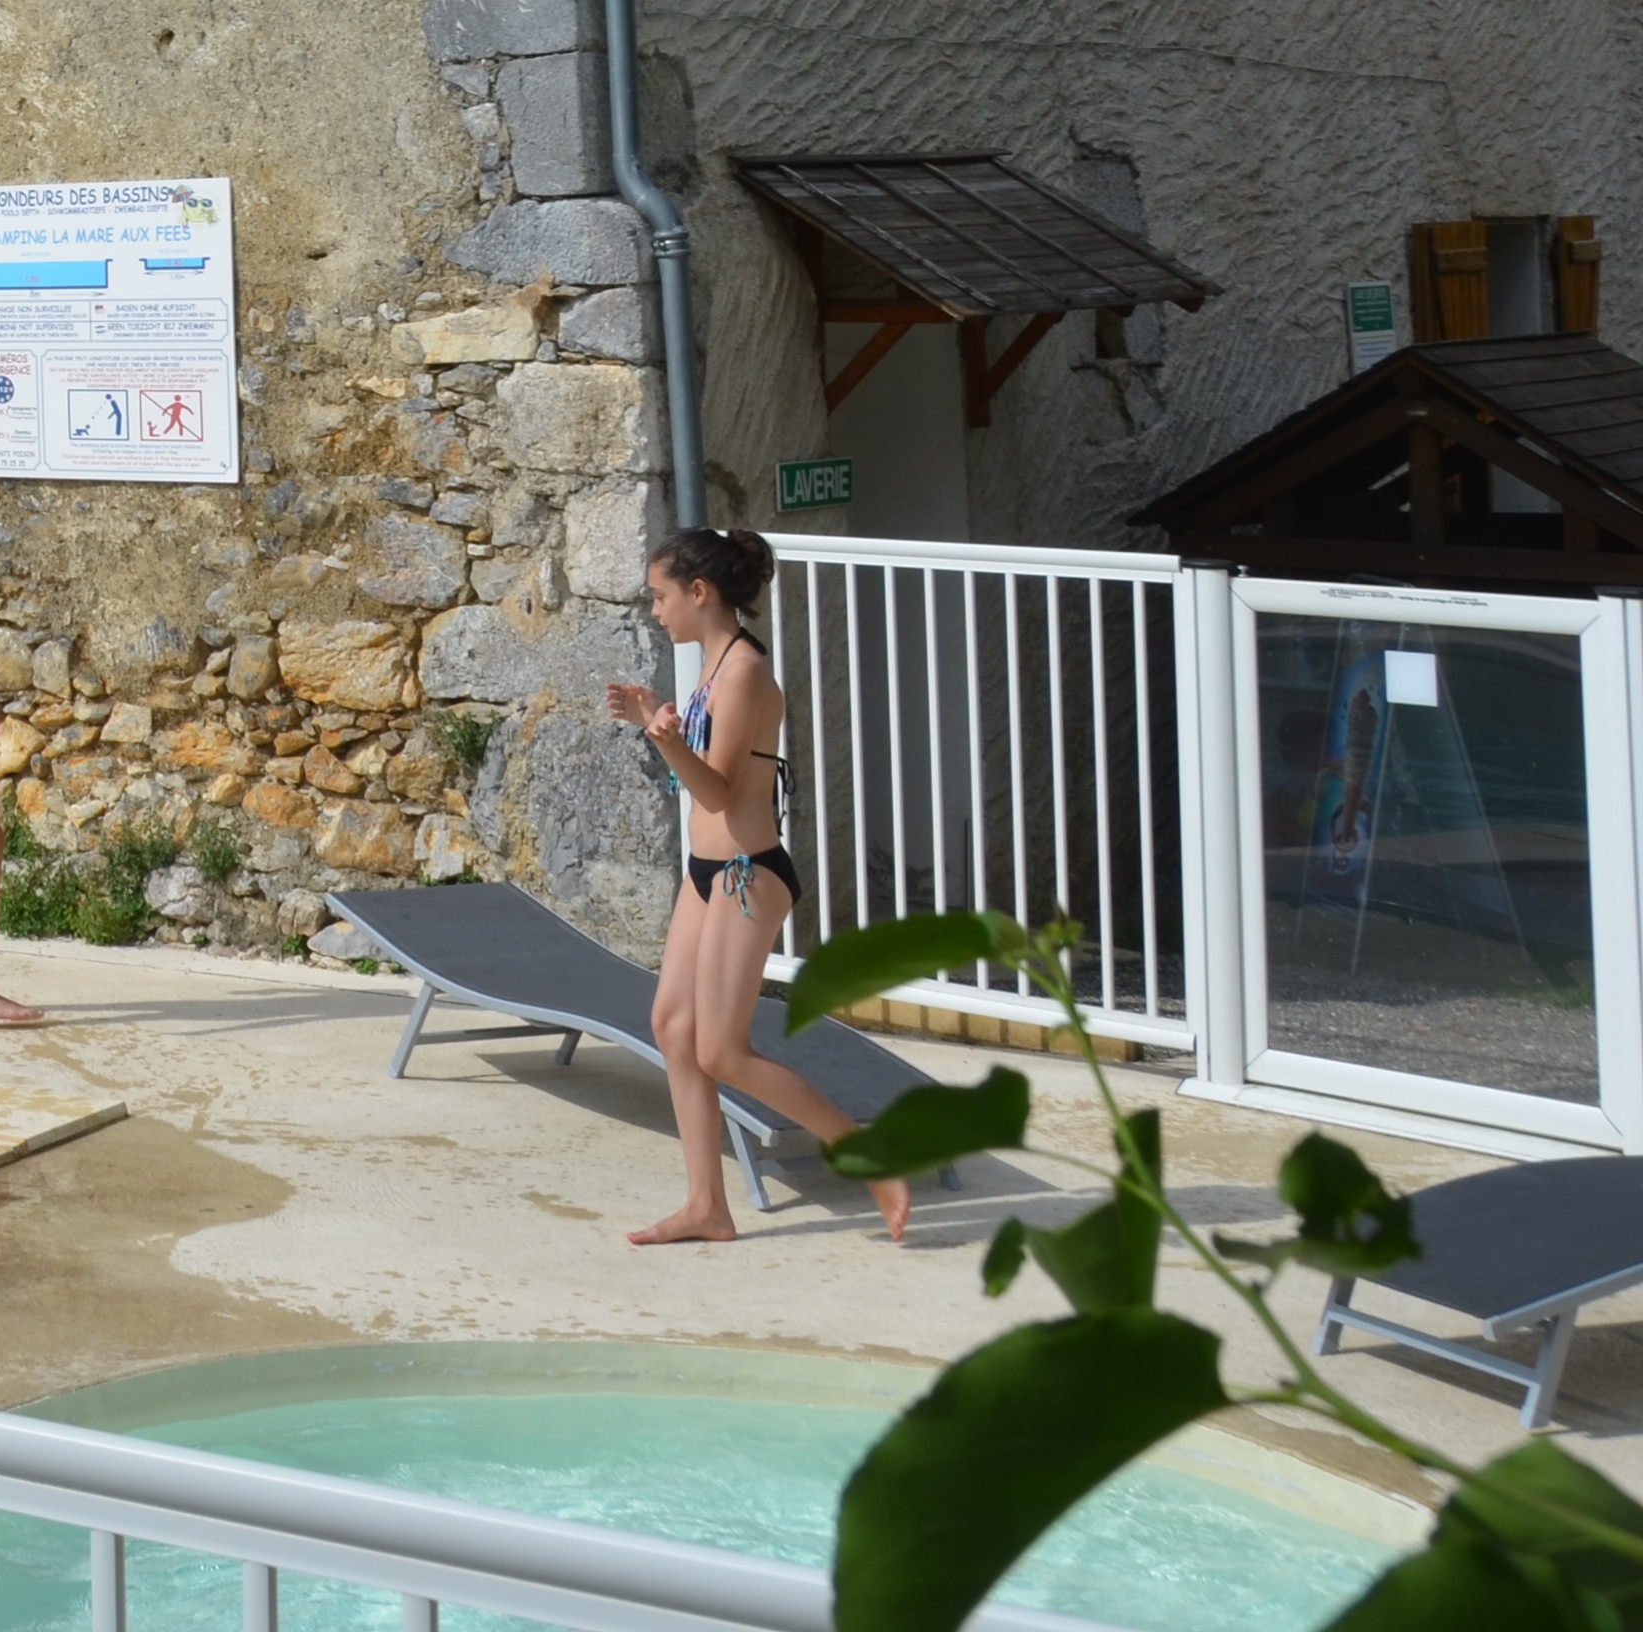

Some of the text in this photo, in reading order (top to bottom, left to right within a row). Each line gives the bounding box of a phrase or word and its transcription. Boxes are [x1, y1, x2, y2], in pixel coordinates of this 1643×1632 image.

[70, 187, 97, 205] DES
[102, 185, 169, 204] BASSINS
[52, 229, 69, 244] LA
[75, 227, 114, 243] MARE
[120, 226, 151, 242] AUX
[782, 465, 850, 504] LAVERIE
